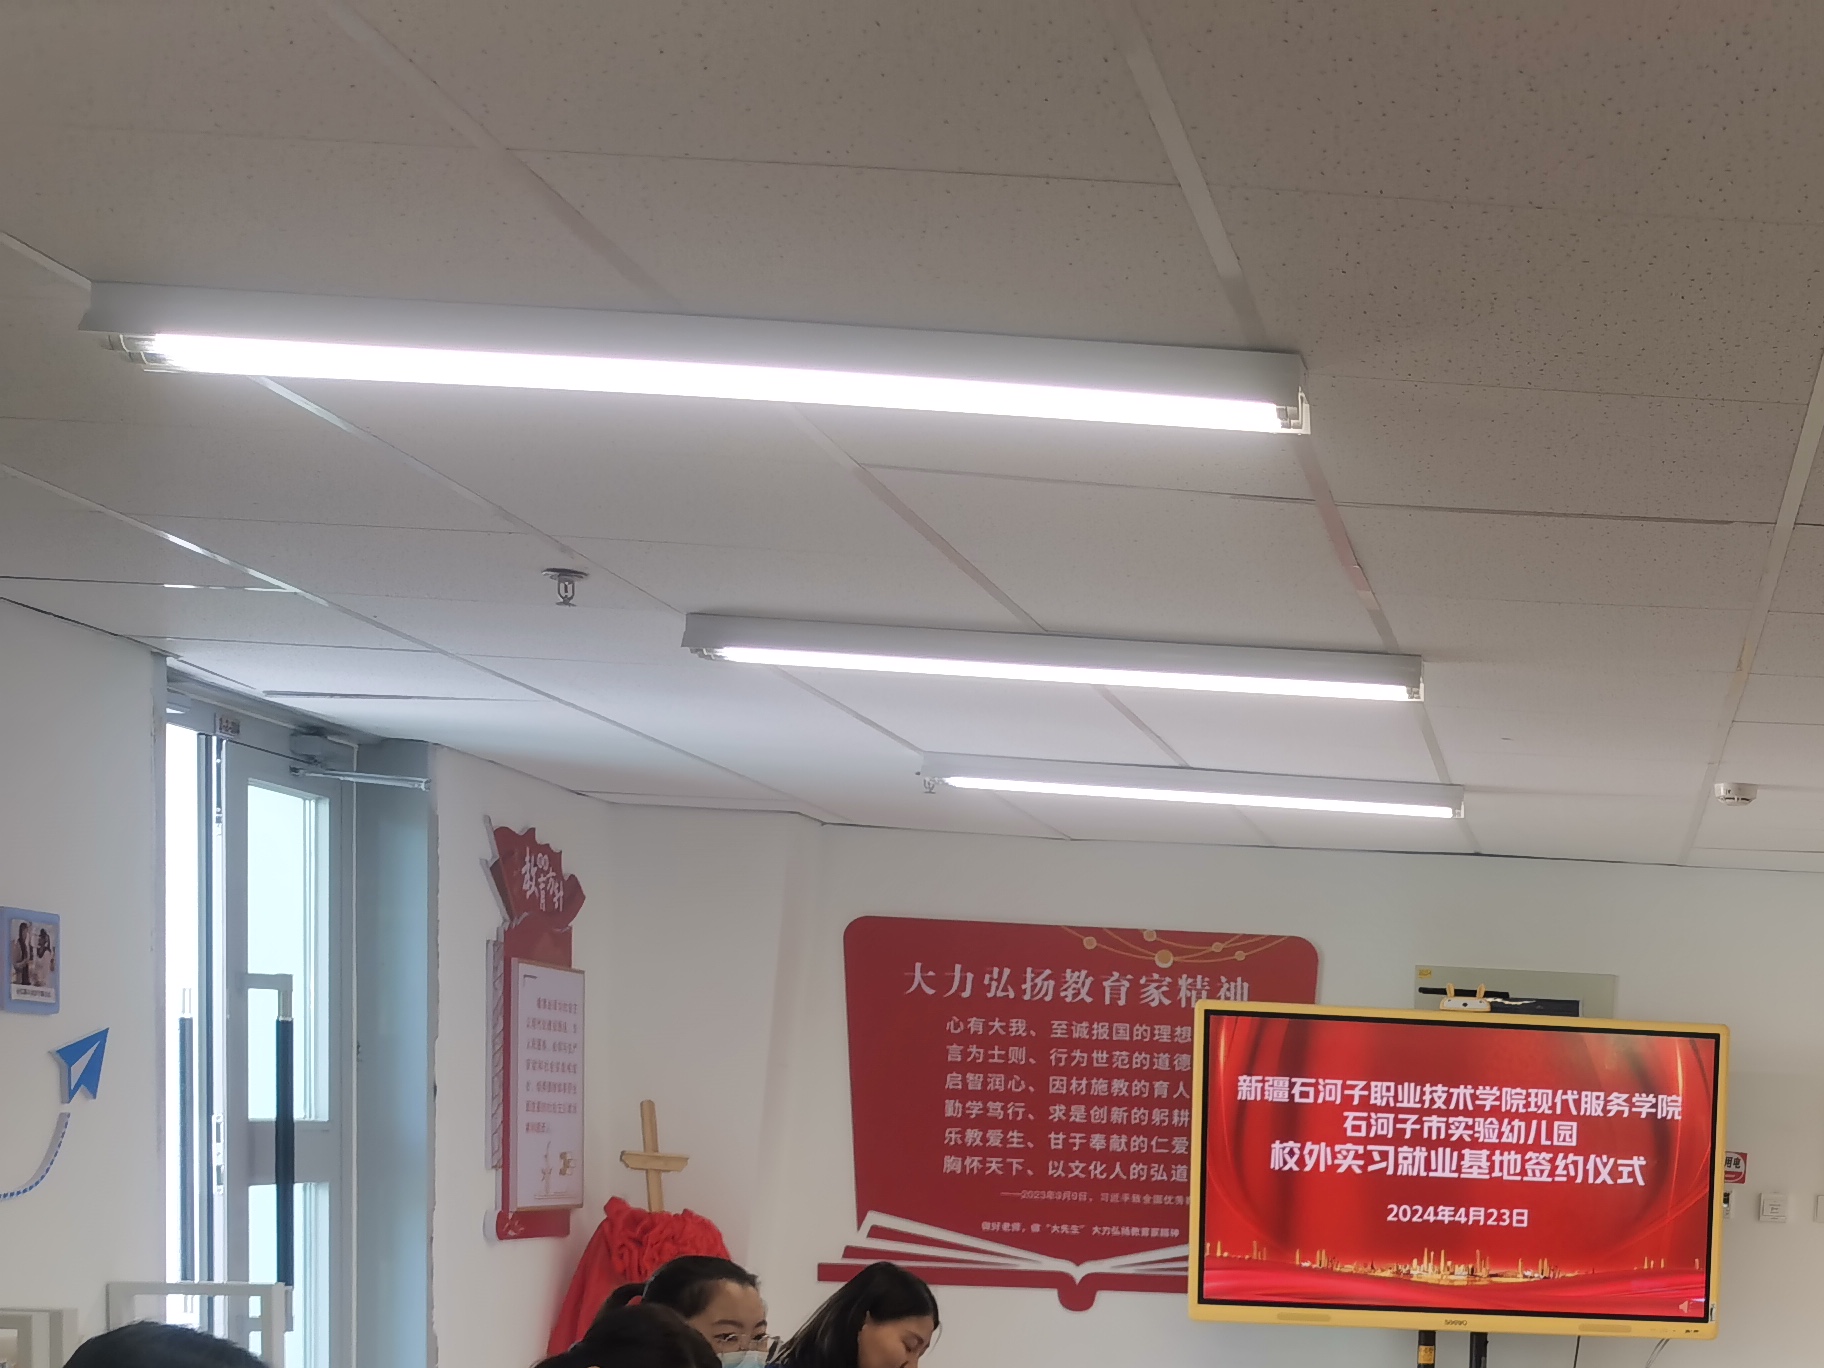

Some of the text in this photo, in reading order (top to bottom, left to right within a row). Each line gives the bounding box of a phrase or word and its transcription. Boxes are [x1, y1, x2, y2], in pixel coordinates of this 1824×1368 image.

[904, 962, 1250, 1008] 大力弘扬教育家精神
[946, 1016, 1192, 1044] 心有大我、至诚报国的理想
[945, 1043, 1192, 1071] 言为士则、行为世范的道德
[944, 1072, 1191, 1099] 启智润心、因材施教的育人
[1236, 1074, 1683, 1121] 新疆石河子职业技术学院现代服务学院
[944, 1099, 1191, 1126] 勤学笃行、求是创新的躬耕
[943, 1127, 1190, 1155] 乐教爱生、甘于奉献的仁爱
[1342, 1111, 1578, 1147] 石河子市实验幼儿园
[942, 1155, 1189, 1183] 胸怀天下、以文化人的弘道
[1270, 1140, 1648, 1187] 校外实习就业基地签约仪式
[1386, 1203, 1529, 1228] 2024年4月23日
